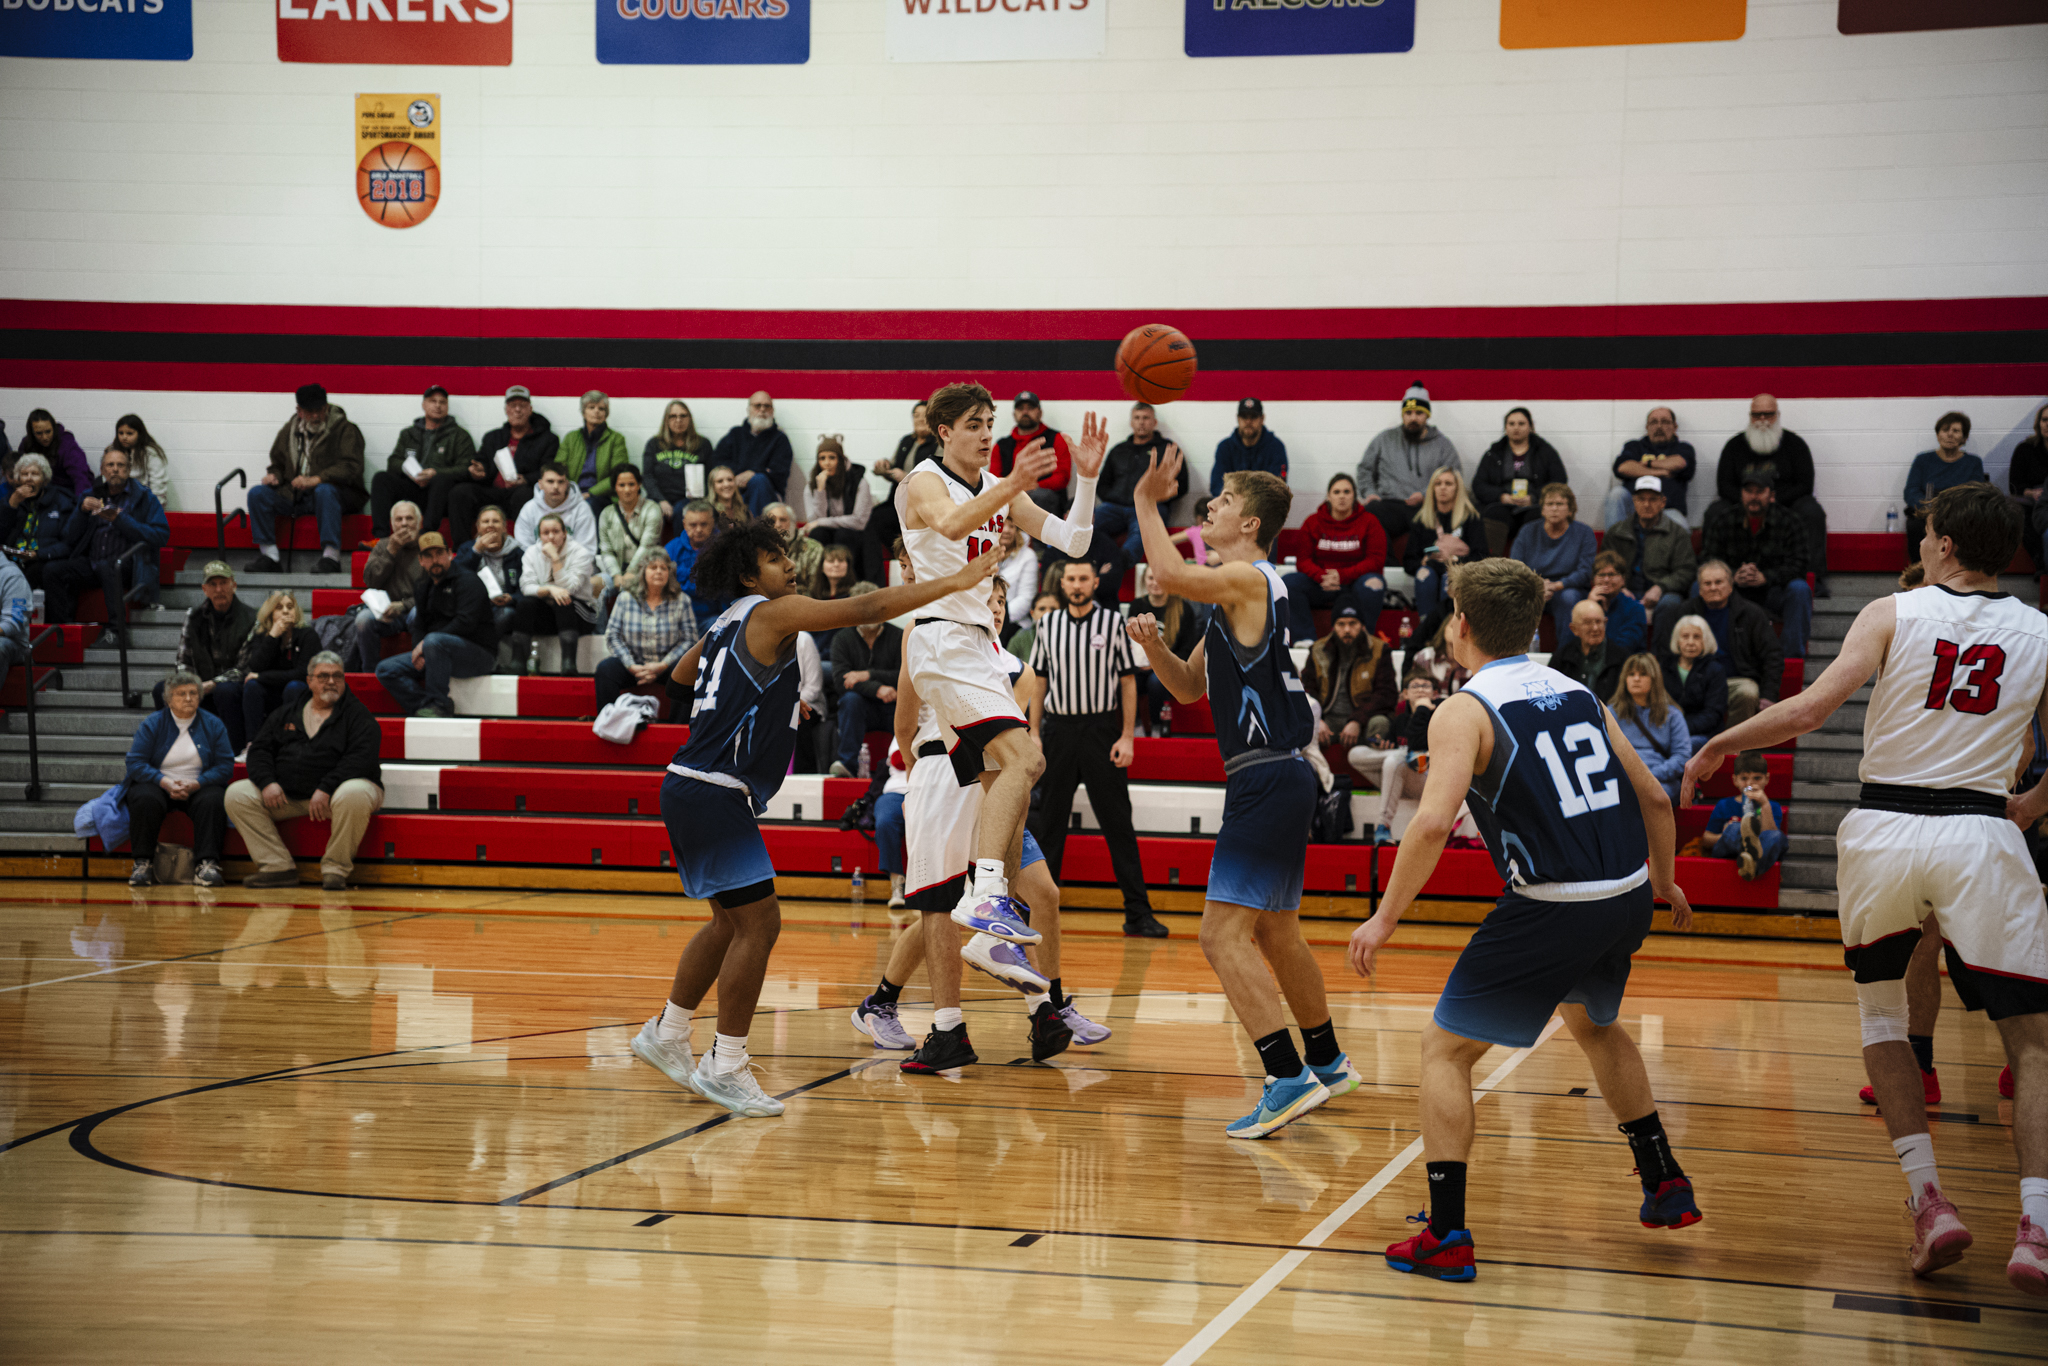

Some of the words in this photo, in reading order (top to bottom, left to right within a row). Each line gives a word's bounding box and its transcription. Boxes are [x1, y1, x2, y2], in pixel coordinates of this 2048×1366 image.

[616, 0, 789, 20] COUGARS
[372, 179, 422, 200] 2018
[1924, 638, 2007, 716] 13
[1534, 721, 1620, 819] 12
